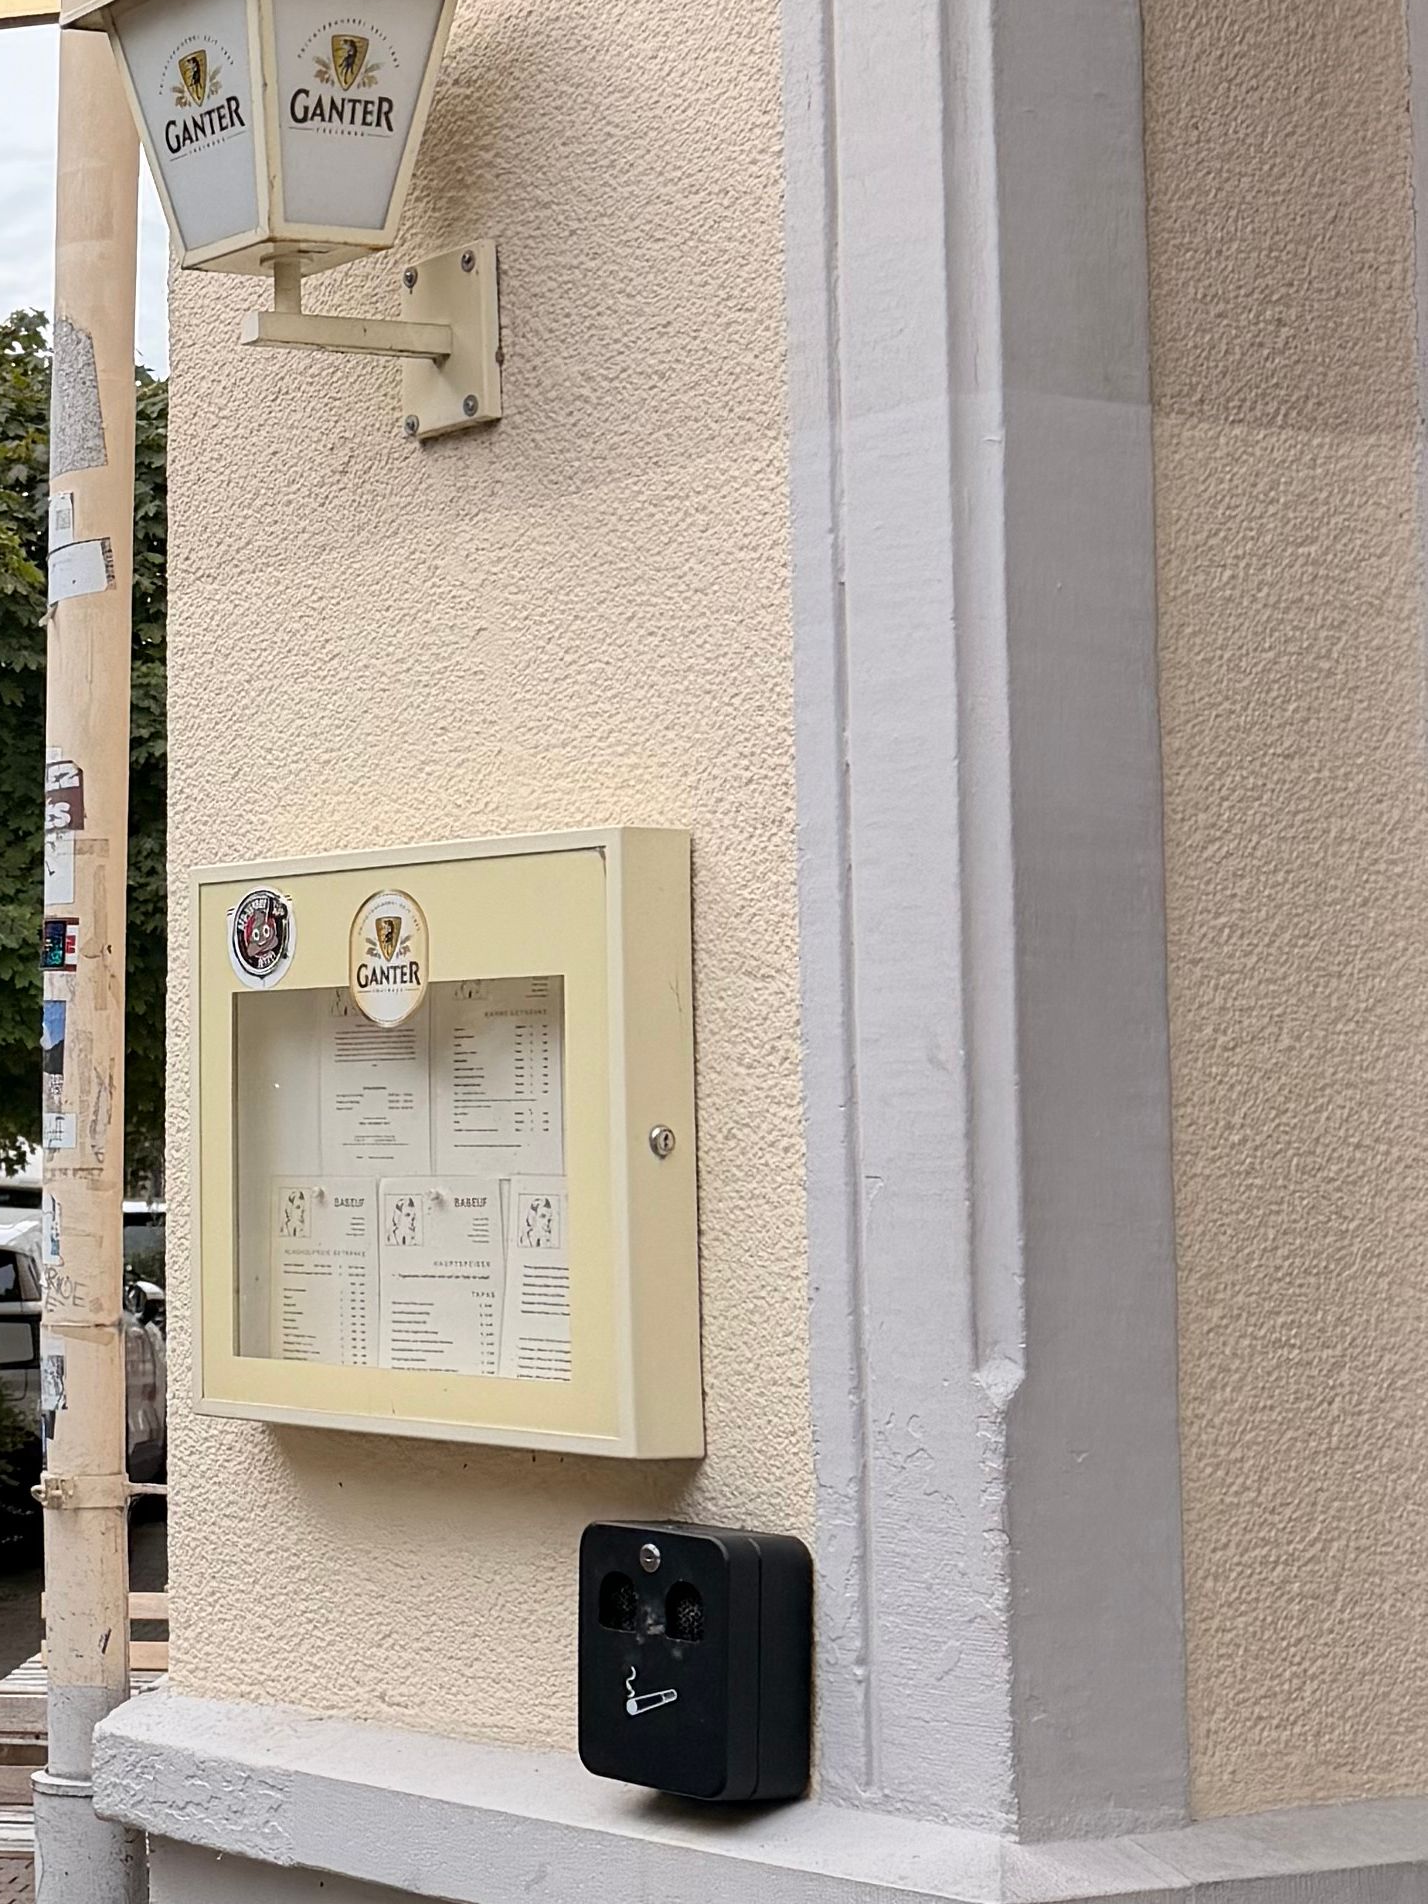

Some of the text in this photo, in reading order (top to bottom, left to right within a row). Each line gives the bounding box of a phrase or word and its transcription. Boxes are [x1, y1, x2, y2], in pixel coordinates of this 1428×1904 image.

[164, 95, 246, 155] GANTER
[290, 87, 394, 133] GANTER
[356, 960, 422, 989] GANTER
[454, 1197, 488, 1208] BABEUF
